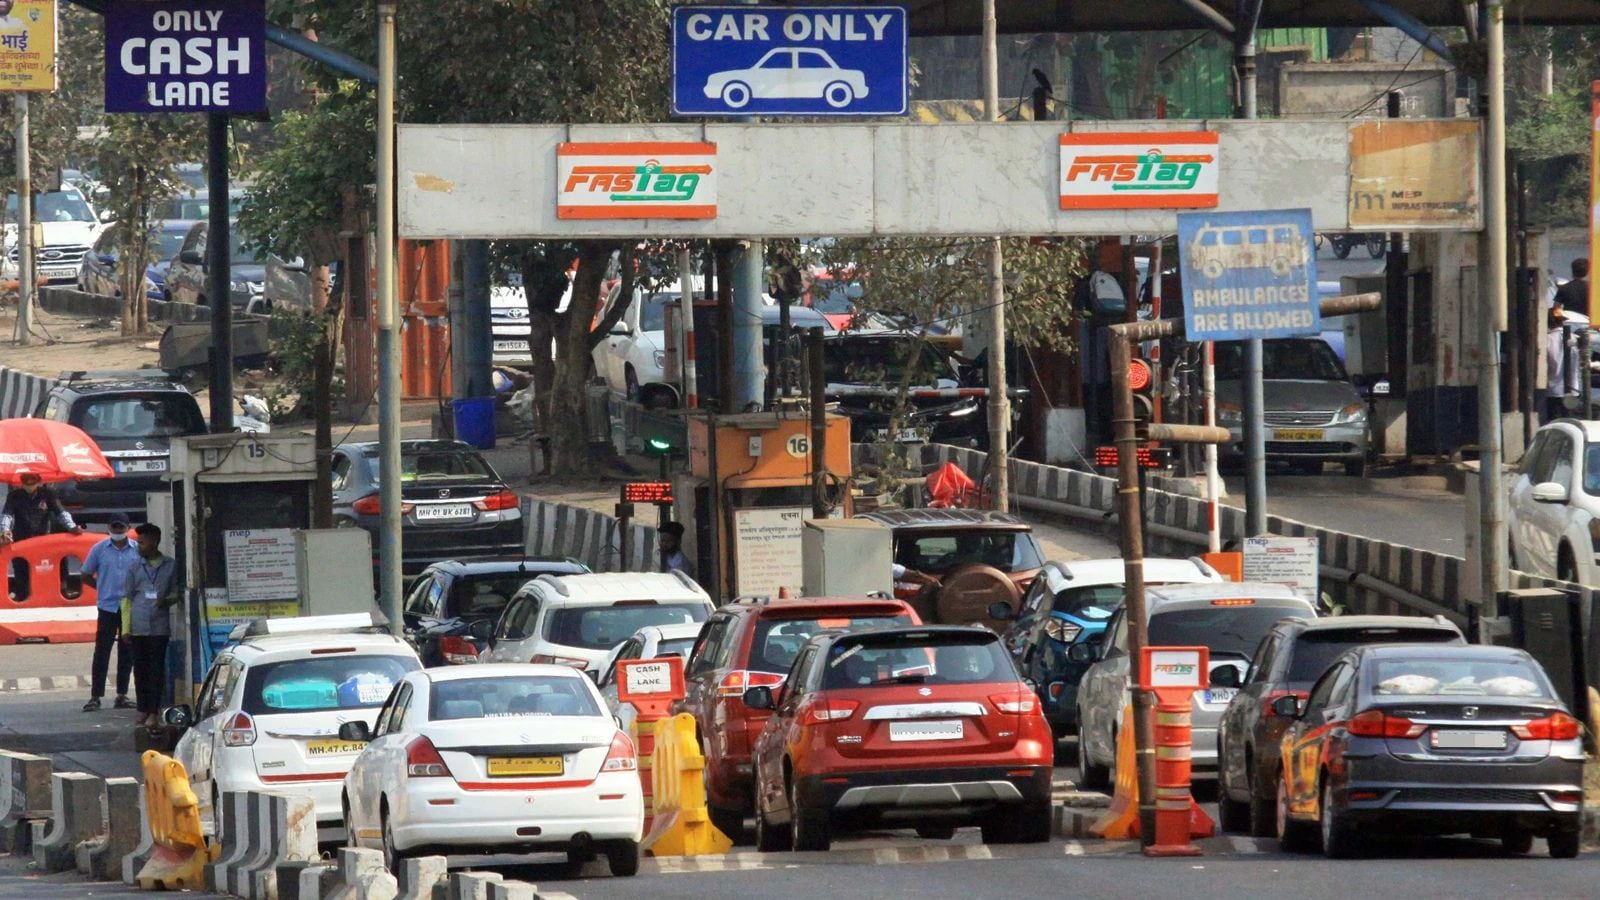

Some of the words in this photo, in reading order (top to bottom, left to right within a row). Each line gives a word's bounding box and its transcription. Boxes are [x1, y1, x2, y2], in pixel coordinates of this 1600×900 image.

[153, 10, 224, 31] ONLY
[686, 14, 770, 41] CAR
[783, 14, 892, 41] ONLY
[1, 30, 28, 52] भाई
[121, 38, 250, 75] CASH
[149, 82, 230, 106] LANE
[1193, 285, 1309, 307] AMBULANCES
[1193, 313, 1228, 332] ARE
[1232, 310, 1314, 330] ALLOWED
[248, 443, 265, 458] 15
[790, 438, 808, 453] 16
[780, 512, 800, 521] सूचना
[229, 530, 251, 538] mep
[1247, 538, 1269, 547] mep
[636, 665, 660, 673] CASH
